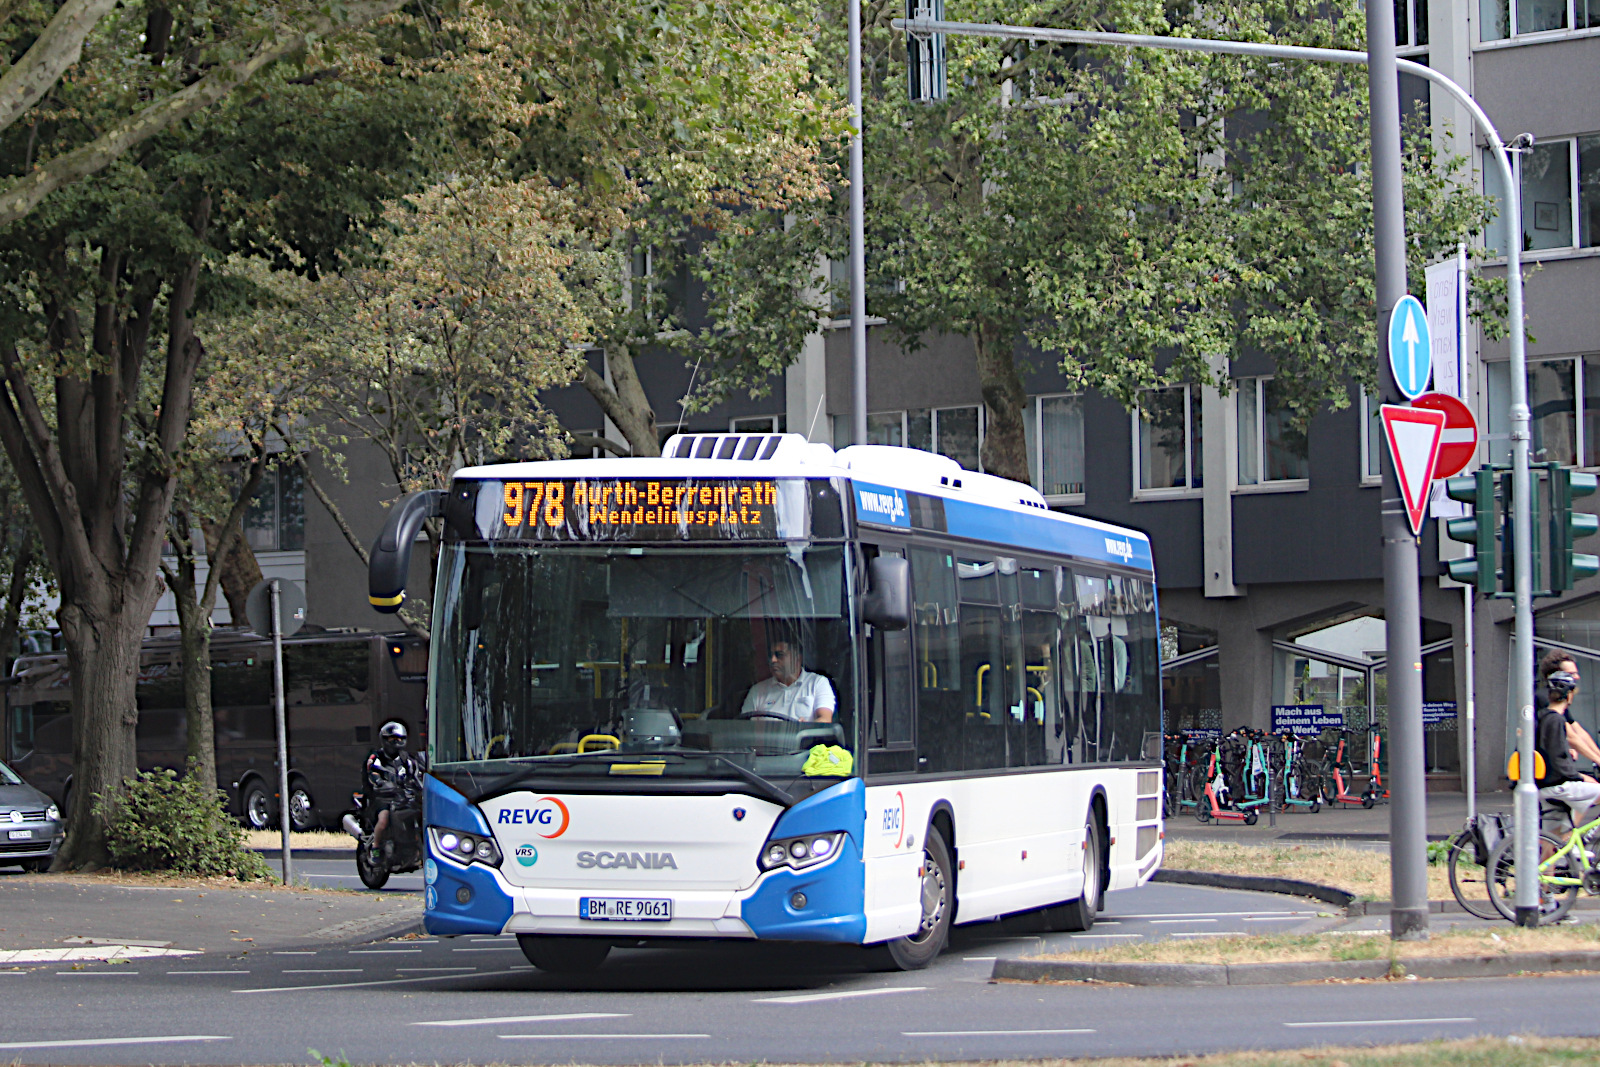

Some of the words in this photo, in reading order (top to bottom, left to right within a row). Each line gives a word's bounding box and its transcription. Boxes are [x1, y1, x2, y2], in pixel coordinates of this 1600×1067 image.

[503, 481, 565, 527] 978
[859, 489, 905, 522] www.revg.de
[589, 505, 762, 526] Wendelinusplatz
[1275, 707, 1302, 716] Mach
[1304, 708, 1322, 716] aus
[1275, 716, 1311, 725] deinem
[1312, 716, 1341, 724] Leben
[1292, 725, 1320, 734] Werk.
[497, 808, 553, 825] REVG
[882, 807, 900, 830] REVG
[515, 848, 533, 857] VRS
[576, 850, 679, 870] SCANIA
[590, 900, 606, 915] BM
[616, 901, 633, 915] RE
[636, 901, 669, 916] 9061
